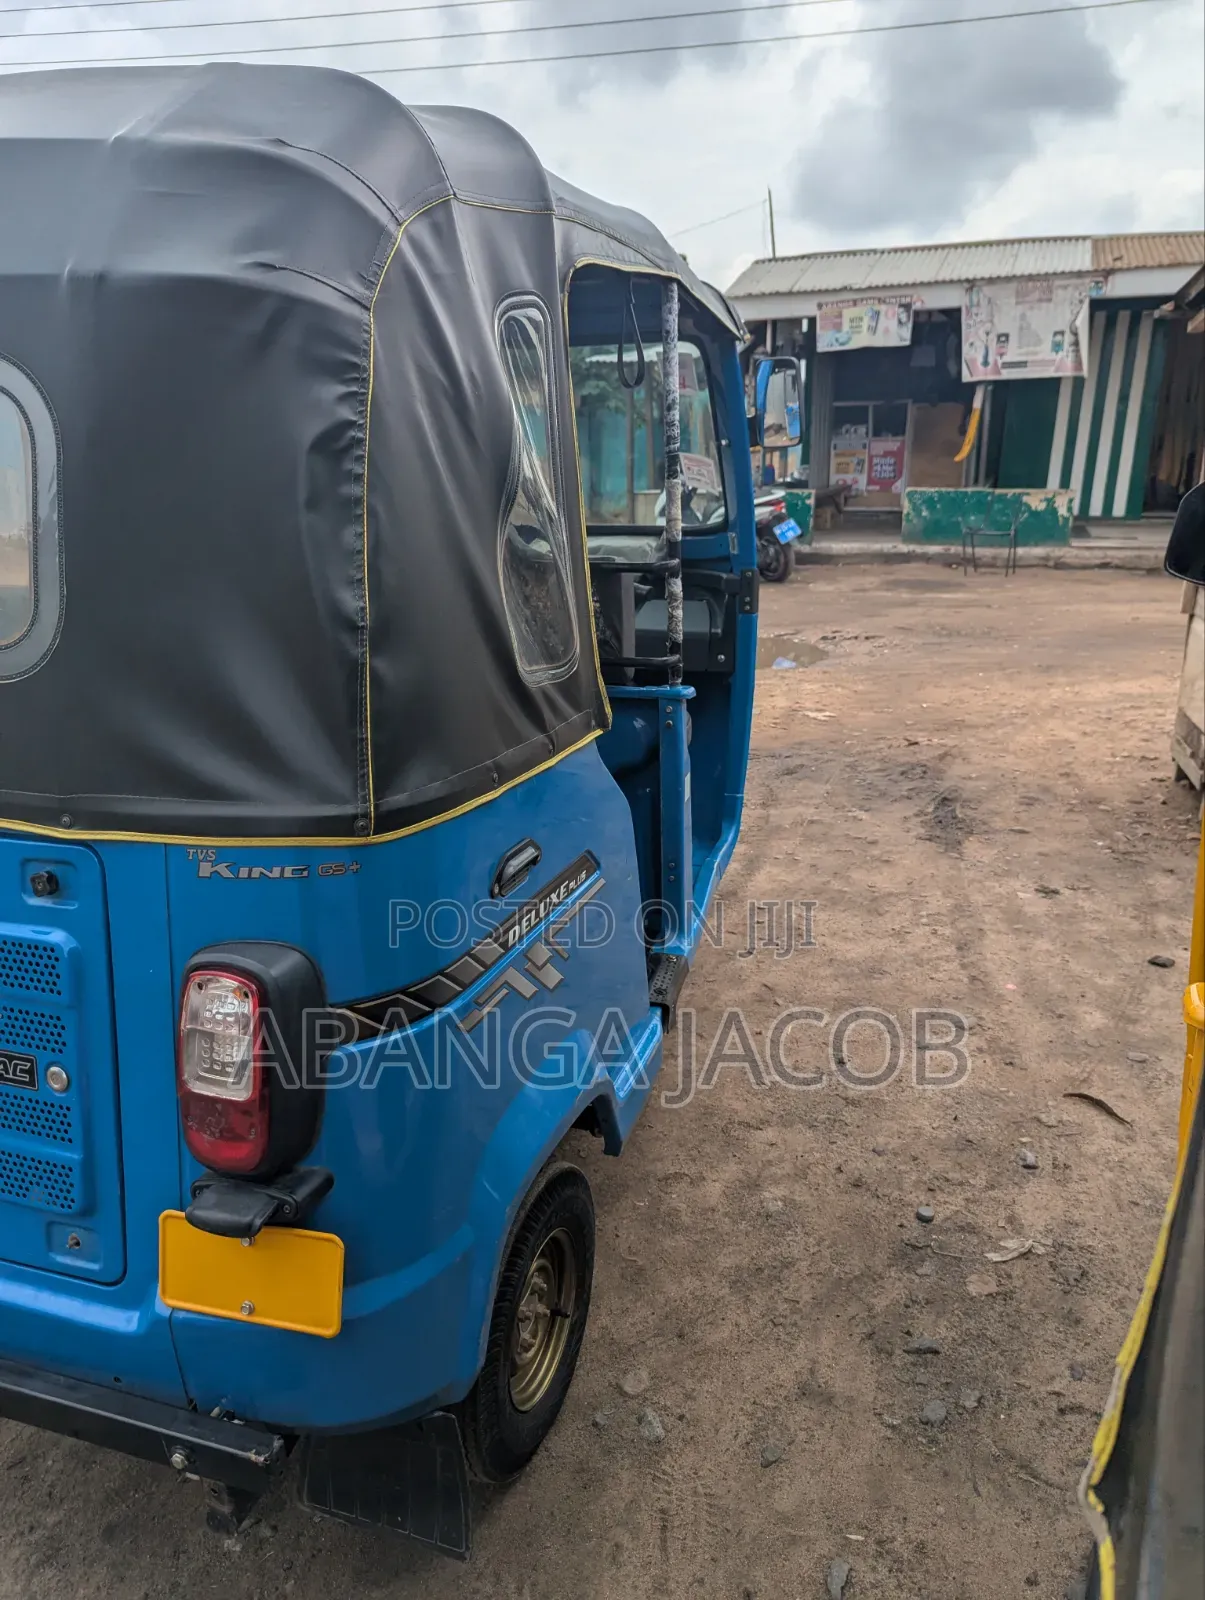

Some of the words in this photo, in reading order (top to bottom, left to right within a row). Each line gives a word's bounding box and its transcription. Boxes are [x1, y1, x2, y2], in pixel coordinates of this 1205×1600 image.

[187, 849, 216, 861] TVS
[317, 861, 361, 877] GS+
[508, 880, 569, 947] DELUXE
[568, 870, 587, 892] PLUS
